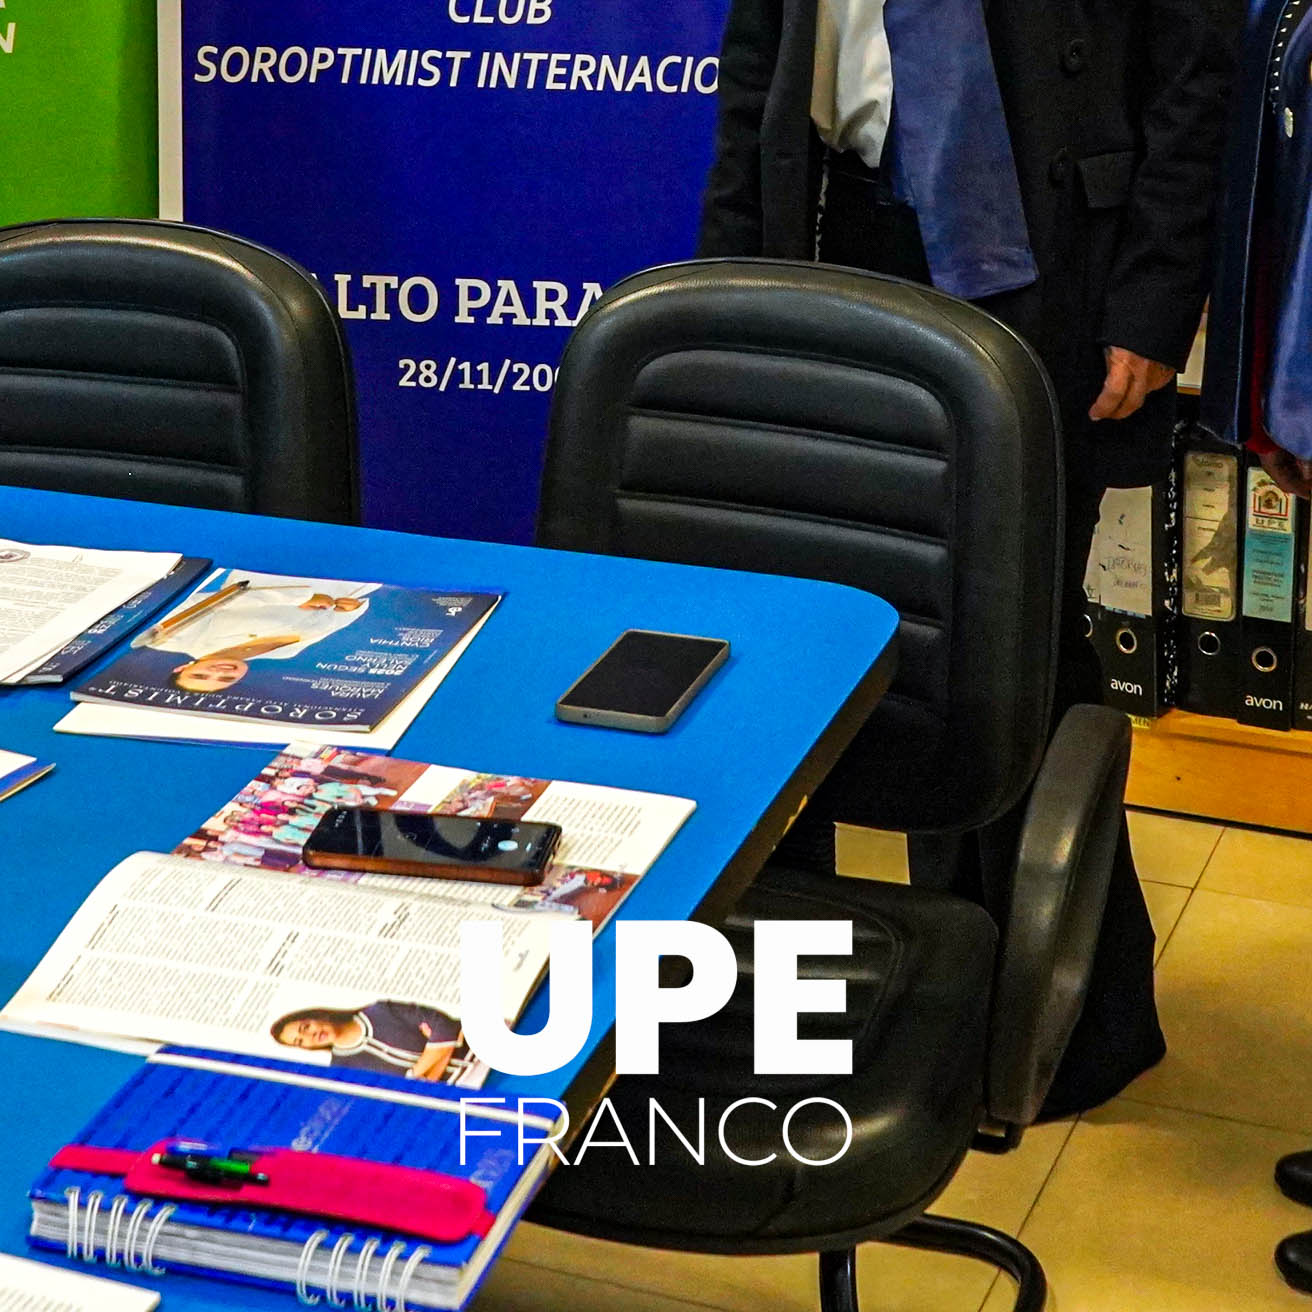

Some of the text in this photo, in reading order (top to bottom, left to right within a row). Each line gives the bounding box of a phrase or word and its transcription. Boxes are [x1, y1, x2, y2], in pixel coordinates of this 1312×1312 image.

[193, 45, 472, 89] SOROPTIMIST
[311, 273, 438, 323] LTO
[398, 356, 561, 394] 28/11/20
[1110, 678, 1143, 696] avon
[1244, 694, 1283, 711] avon
